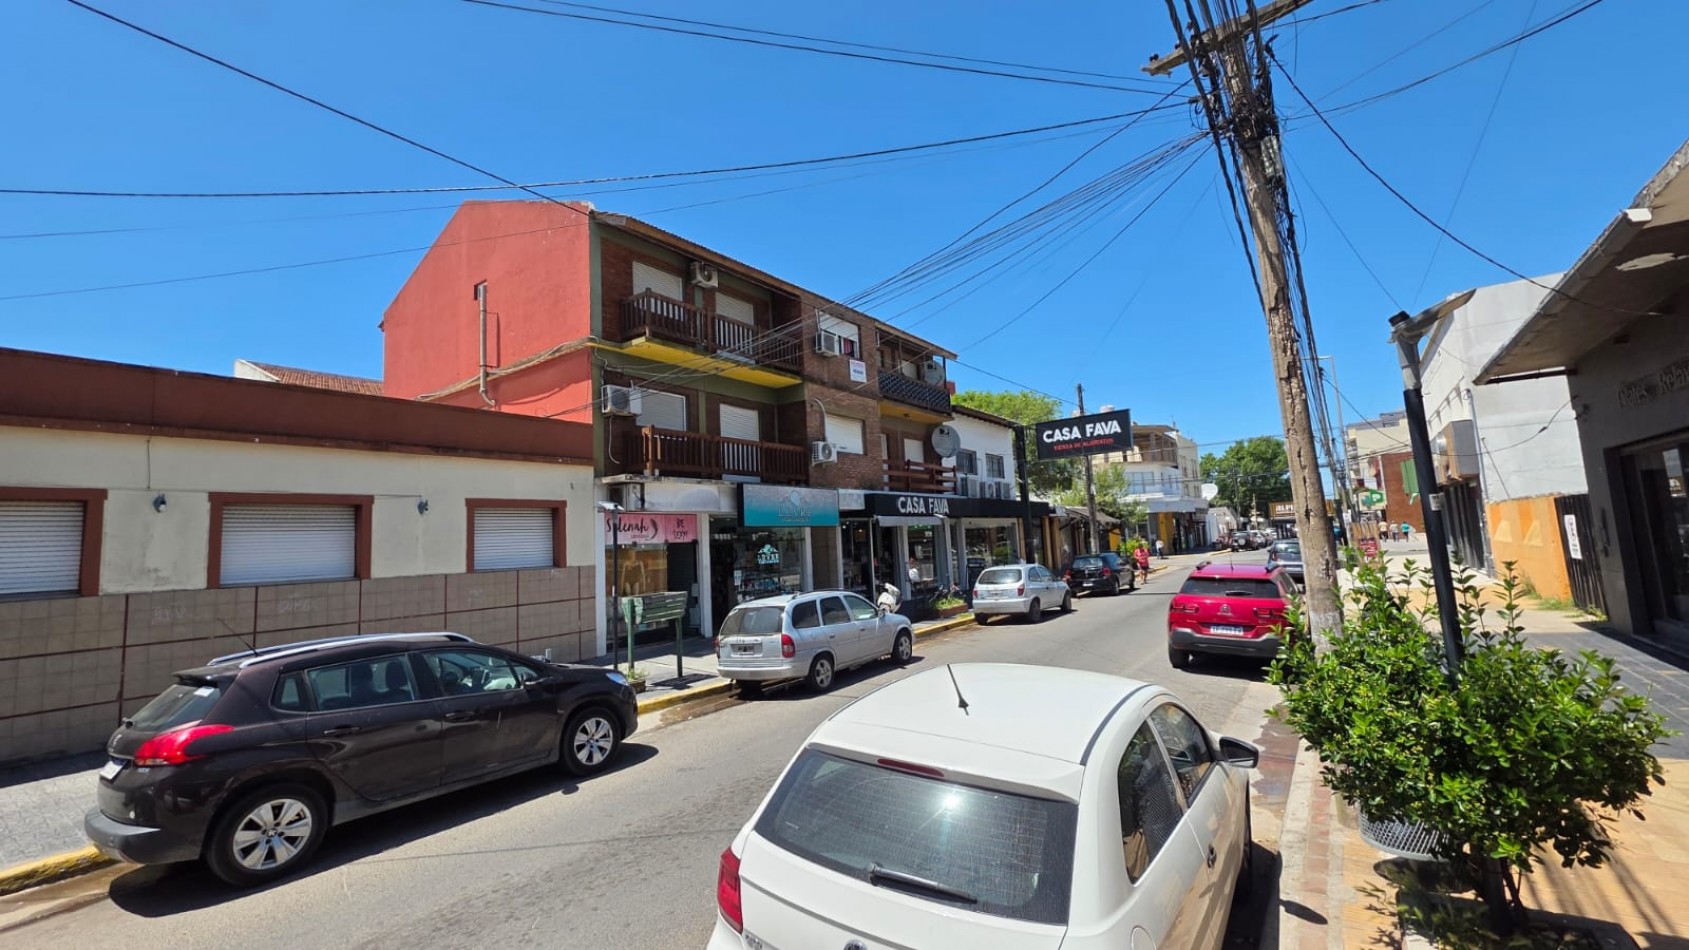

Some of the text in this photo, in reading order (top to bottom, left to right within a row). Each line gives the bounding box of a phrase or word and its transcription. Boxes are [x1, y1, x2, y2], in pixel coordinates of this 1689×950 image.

[1042, 420, 1122, 443] CASA FAVA
[897, 496, 950, 514] CASA FAVA
[606, 516, 649, 533] Slenah
